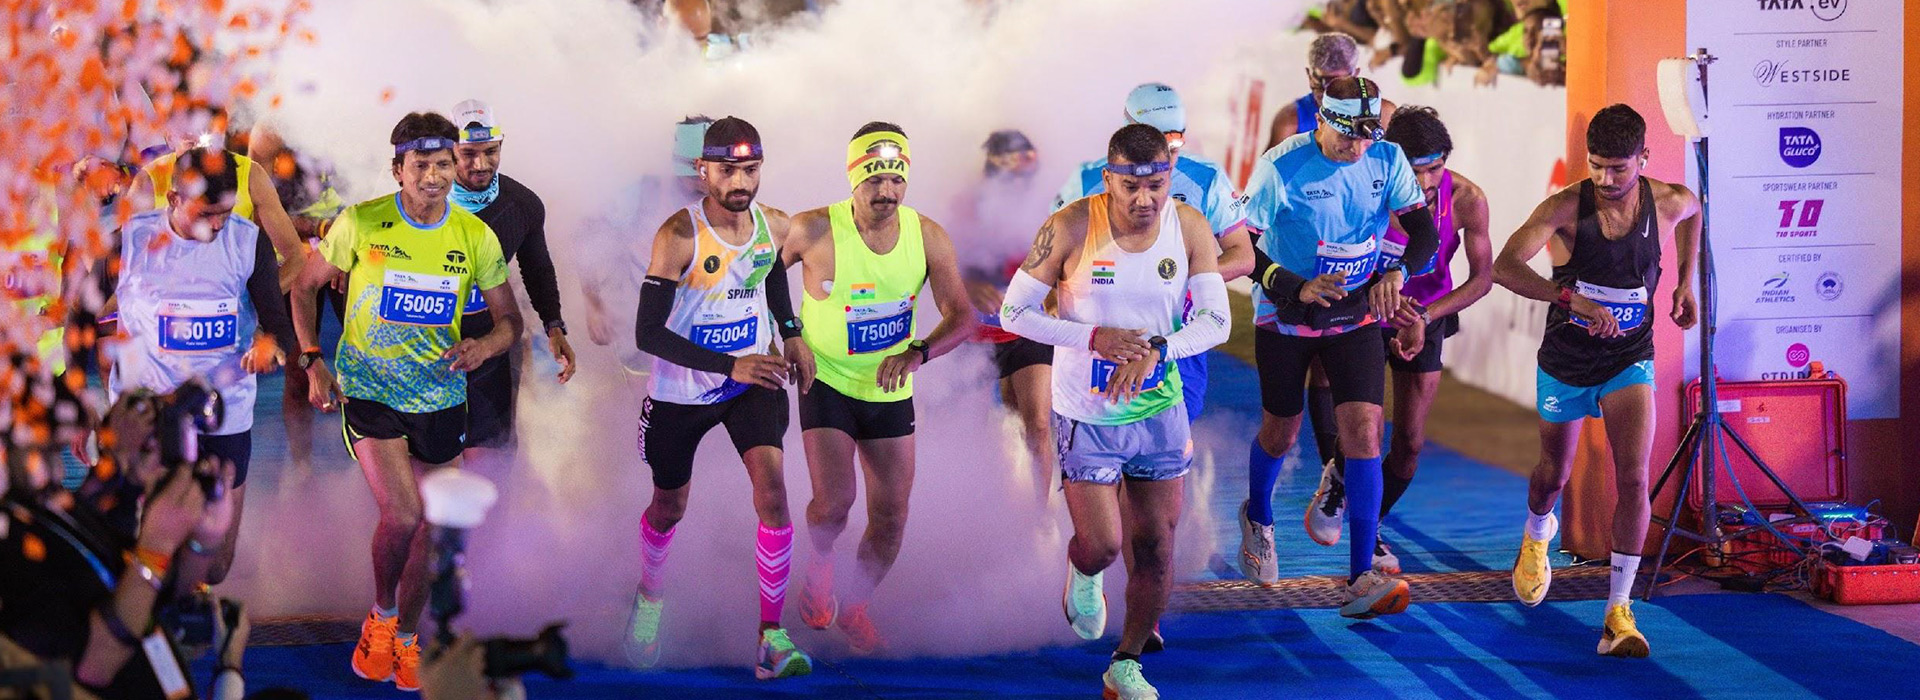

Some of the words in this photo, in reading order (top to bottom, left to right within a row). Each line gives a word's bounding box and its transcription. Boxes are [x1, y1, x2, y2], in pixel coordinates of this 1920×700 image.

[1757, 0, 1804, 10] TATA
[1776, 40, 1796, 48] STYLE
[1798, 39, 1827, 47] PARTNER
[1753, 59, 1850, 87] WESTSIDE
[1767, 111, 1804, 120] HYDRATION
[1805, 111, 1835, 119] PARTNER
[1784, 135, 1814, 145] TATA
[865, 159, 904, 174] TATA
[1763, 183, 1807, 192] SPORTSWEAR
[1808, 182, 1838, 191] PARTNER
[753, 258, 771, 268] INDIA
[1778, 255, 1811, 263] CERTIFIED
[1813, 254, 1822, 262] BY
[443, 264, 468, 274] TATA
[1092, 277, 1115, 285] INDIA
[394, 292, 446, 315] 75005
[171, 320, 225, 341] 75013
[702, 322, 749, 345] 75004
[858, 317, 904, 343] 75006
[1776, 326, 1812, 334] ORGANISED
[1814, 325, 1822, 333] BY
